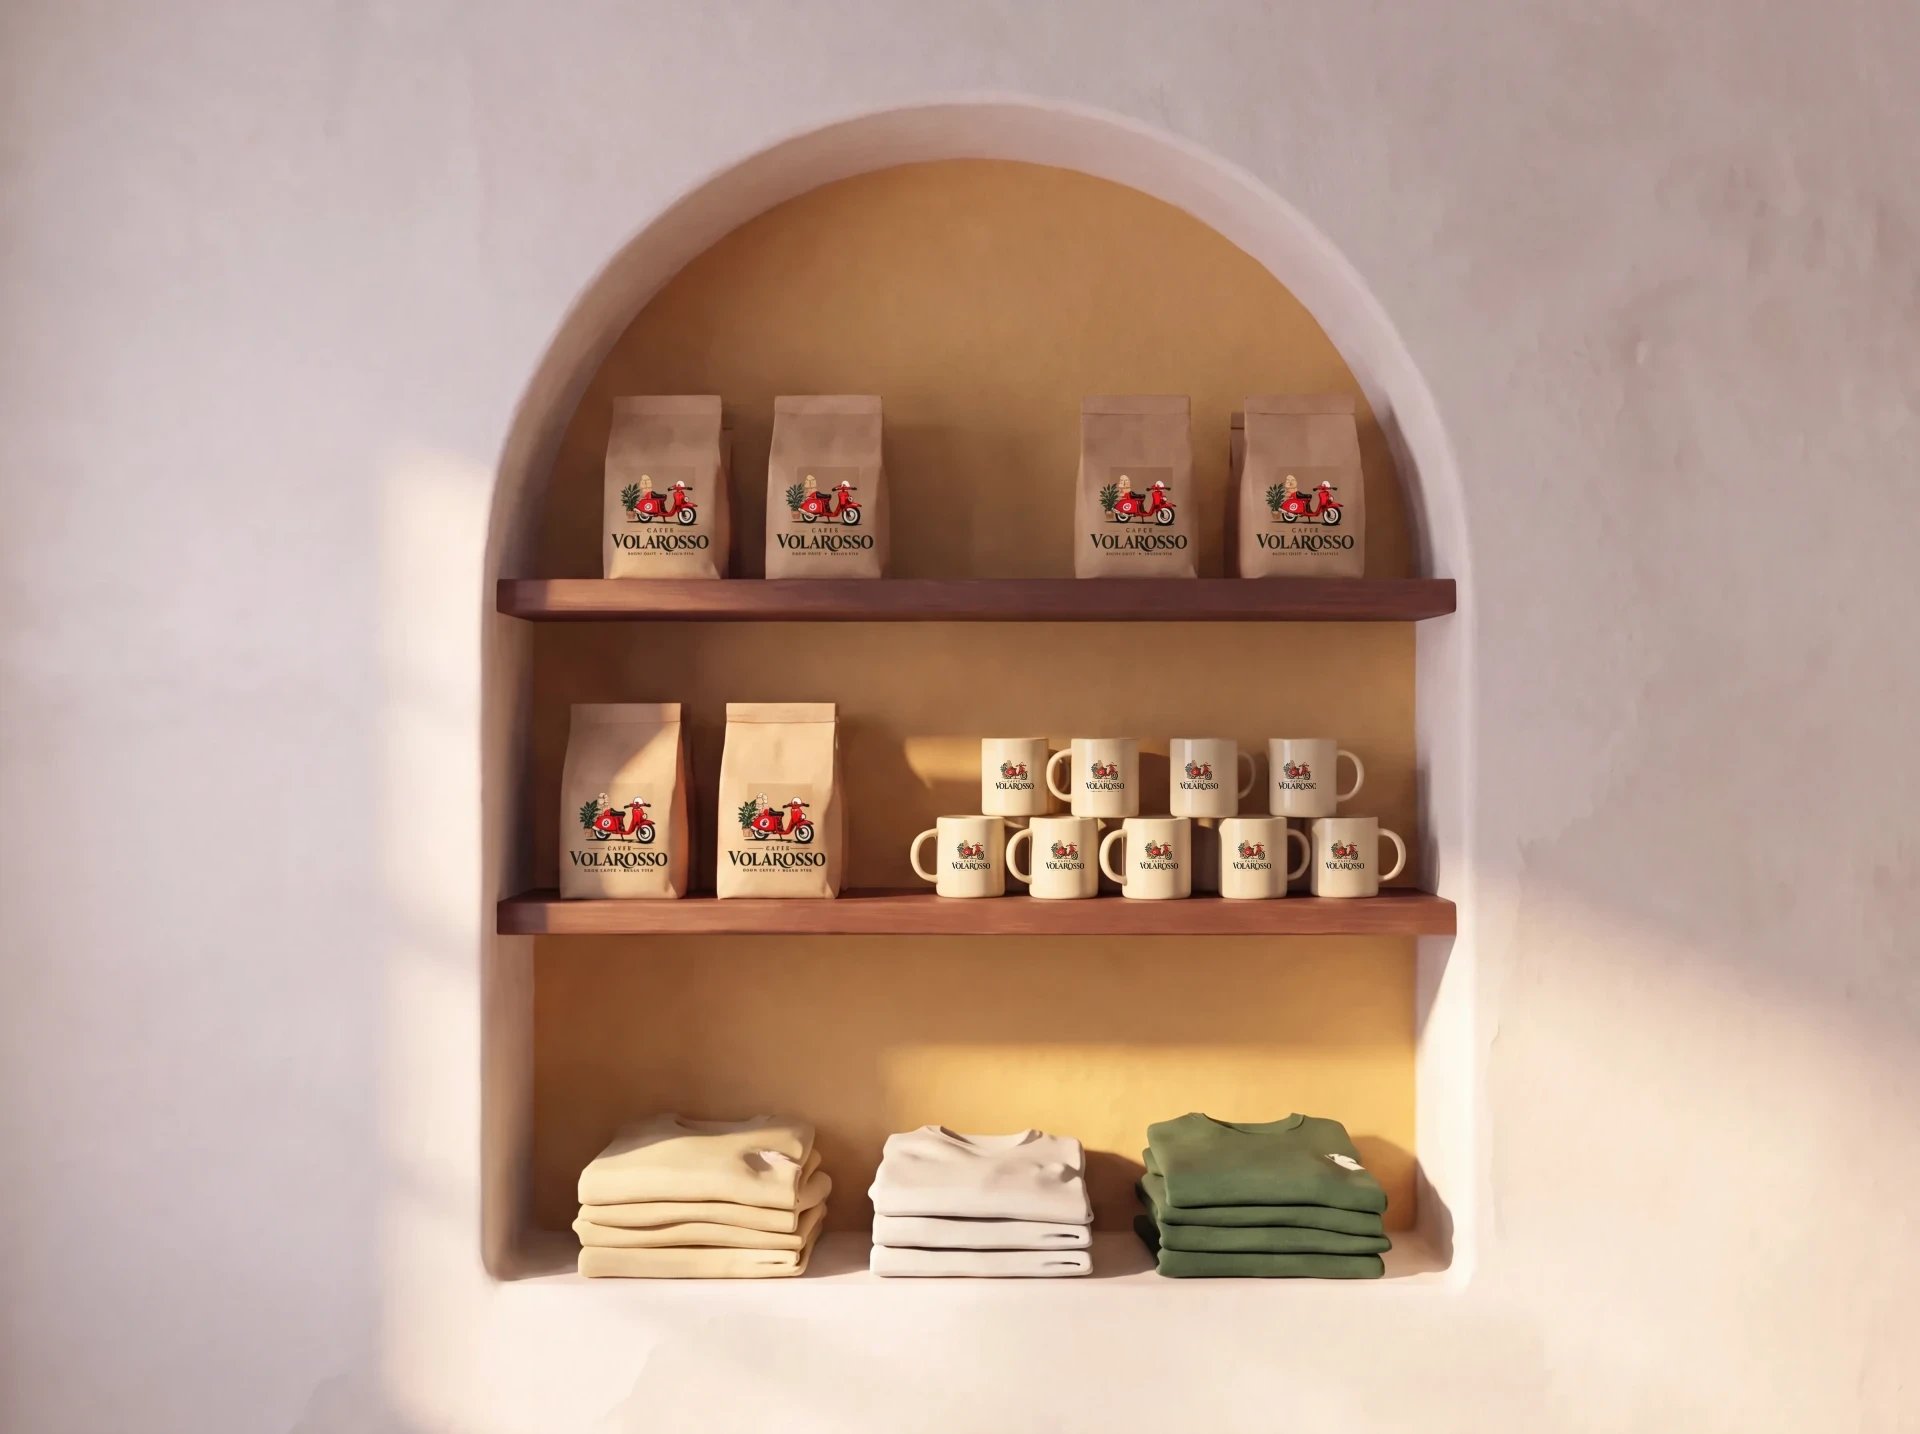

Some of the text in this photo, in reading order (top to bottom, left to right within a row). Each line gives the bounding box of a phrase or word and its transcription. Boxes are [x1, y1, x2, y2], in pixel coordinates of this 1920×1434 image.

[611, 533, 710, 552] VOLAROSSO
[776, 533, 875, 552] VOLAROSSO
[1090, 533, 1189, 552] VOLAROSSO
[1256, 533, 1355, 552] VOLAROSSO
[995, 781, 1035, 790] VOLAROSSO
[1086, 781, 1125, 790] VOLAROSSO
[1179, 781, 1219, 790] VOLAROSSO
[569, 850, 669, 869] VOLAROSSO
[728, 850, 827, 869] VOLAROSSO
[951, 861, 991, 870] VOLAROSSO
[1046, 861, 1085, 870] VOLAROSSO
[1140, 861, 1179, 870] VOLAROSSO
[1233, 861, 1272, 870] VOLAROSSO
[1325, 861, 1365, 870] VOLAROSSO
